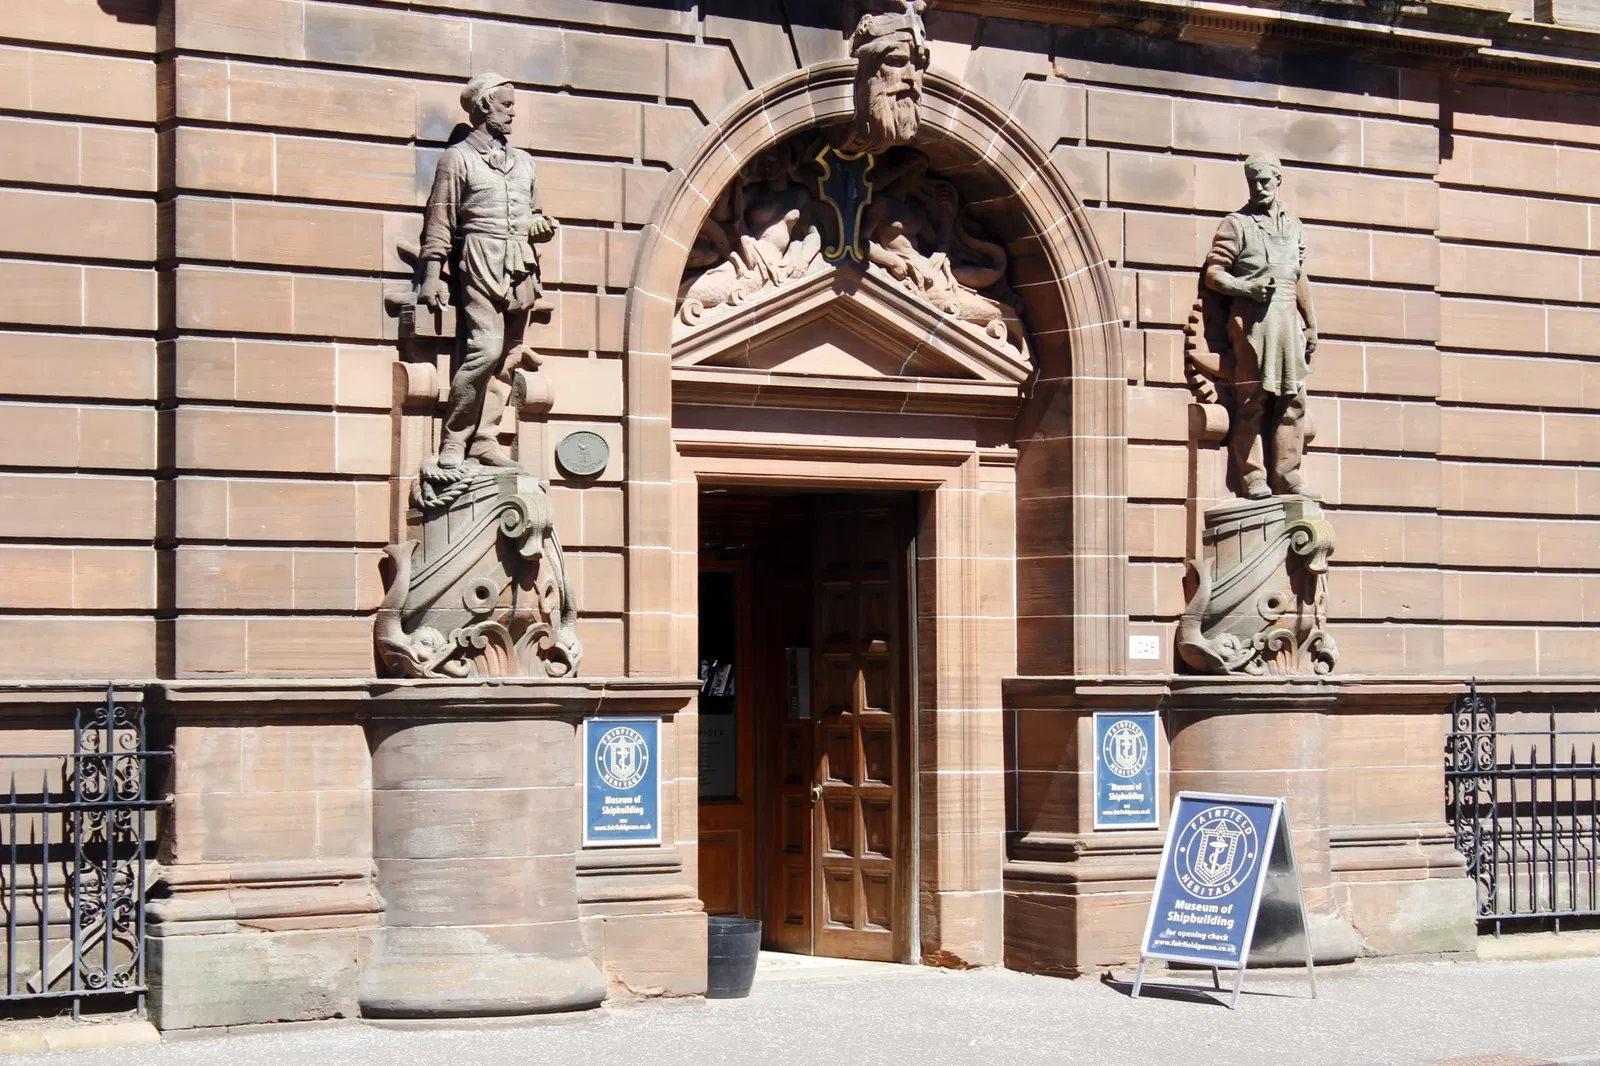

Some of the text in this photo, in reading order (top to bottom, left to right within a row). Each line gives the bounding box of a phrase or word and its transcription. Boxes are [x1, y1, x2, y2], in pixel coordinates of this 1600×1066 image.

[602, 728, 643, 745] FAIRFIELD
[604, 772, 641, 787] HERITAGE
[1111, 782, 1142, 791] Museum of
[605, 794, 642, 804] Museum of
[1108, 792, 1144, 802] Shipbuilding
[602, 805, 644, 816] Shipbuilding
[1191, 809, 1252, 835] FAIRFIELD
[1181, 873, 1239, 896] HERITAGE
[1174, 899, 1234, 914] Museum of
[1167, 911, 1235, 929] Shipbuilding
[1165, 928, 1229, 941] for opening check
[1154, 939, 1237, 953] www.fairfieldgovan.co.uk
